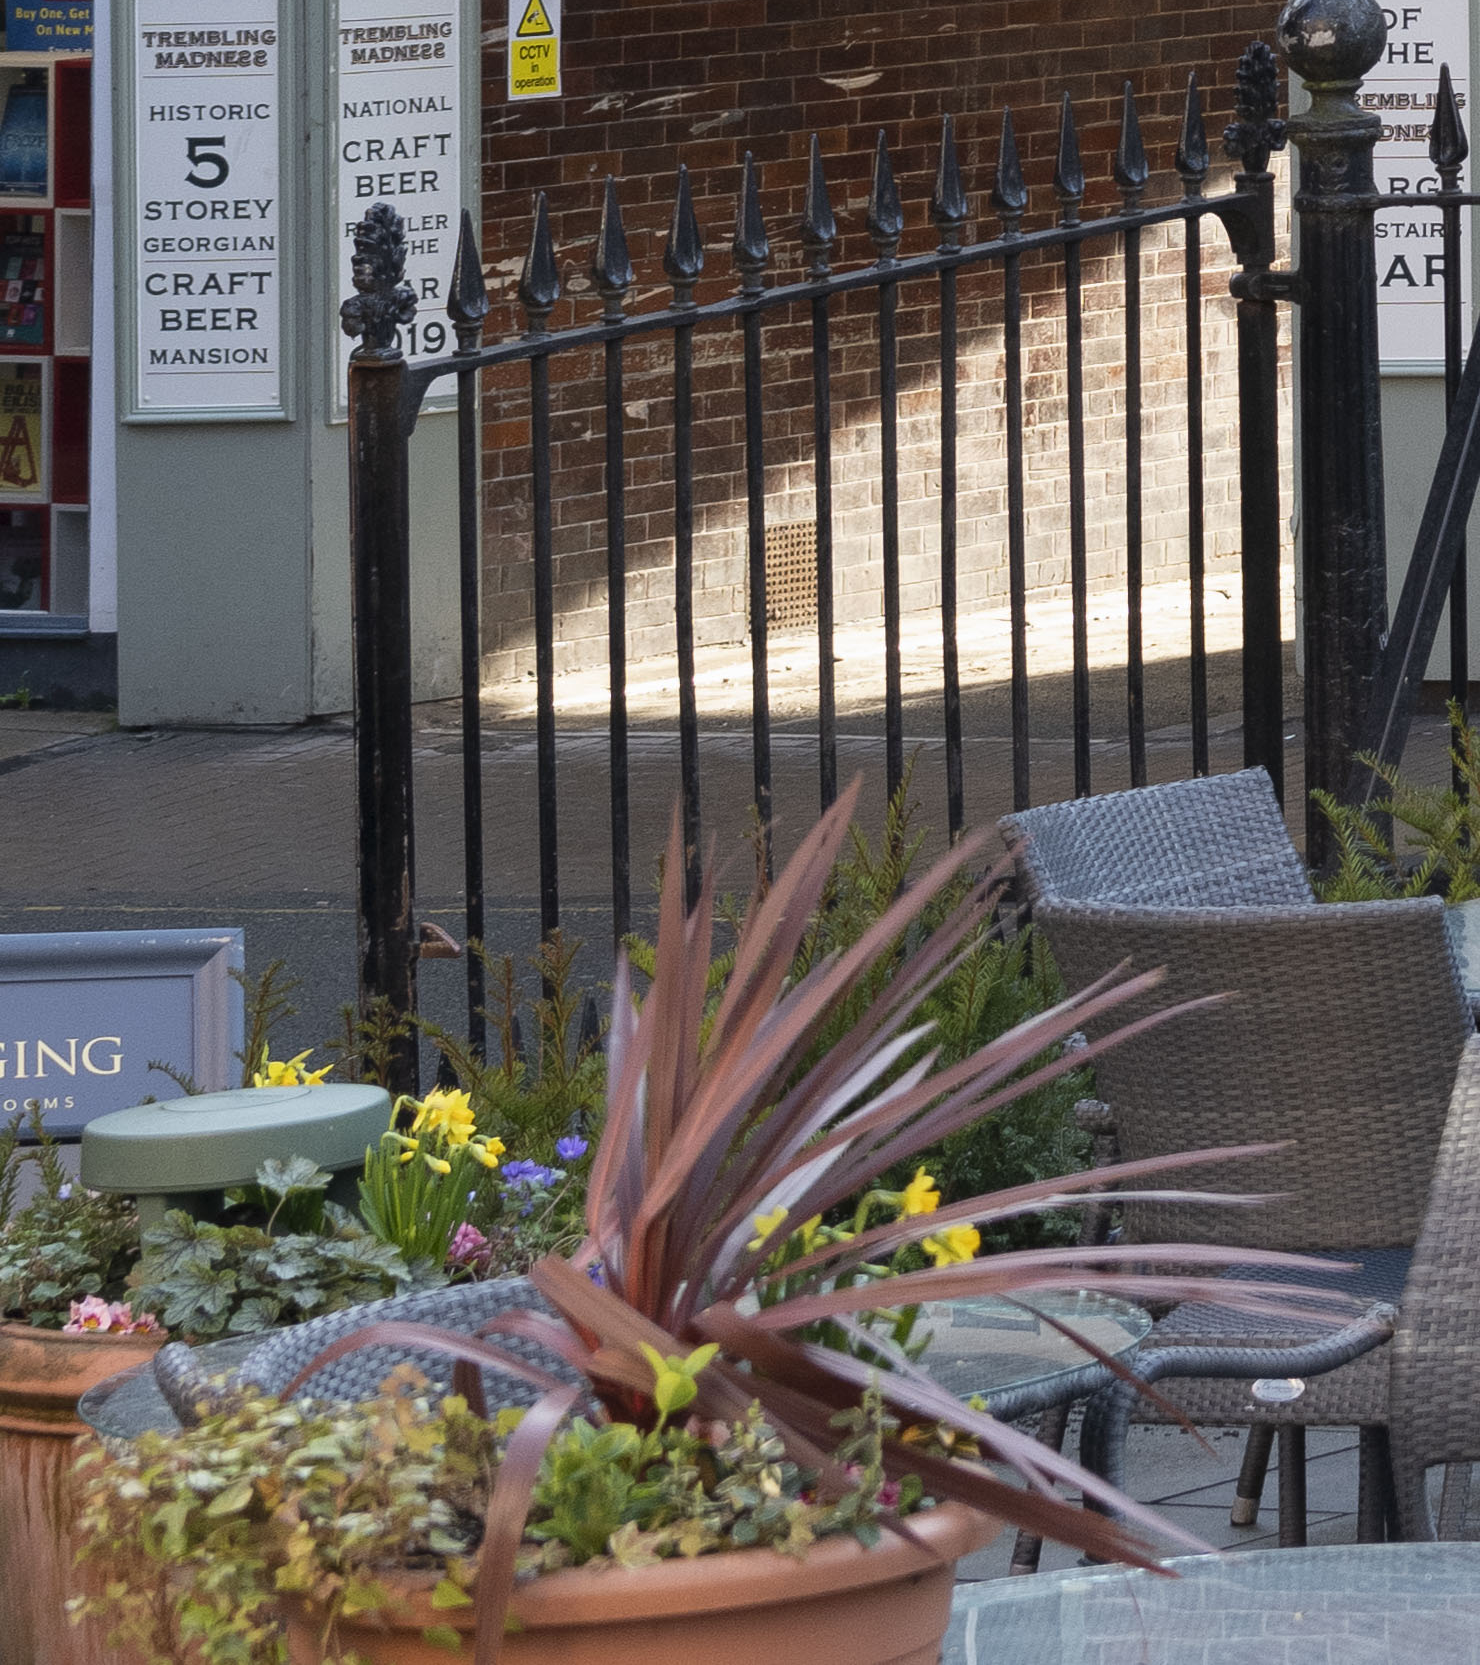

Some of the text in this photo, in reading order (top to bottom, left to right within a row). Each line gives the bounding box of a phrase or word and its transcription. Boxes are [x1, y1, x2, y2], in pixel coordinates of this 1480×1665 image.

[16, 7, 37, 22] Buy
[69, 7, 90, 20] Get
[36, 25, 52, 36] On
[56, 25, 81, 36] New
[142, 30, 276, 47] TREMBLING
[340, 22, 452, 44] TREMBLING
[155, 50, 268, 69] MADNESS
[351, 42, 445, 64] MADNESS
[520, 44, 550, 60] CCTV
[1381, 41, 1434, 64] HE
[531, 62, 539, 73] in
[515, 76, 555, 90] operation
[150, 104, 270, 121] HISTORIC
[343, 96, 452, 118] NATIONAL
[343, 133, 451, 163] CRAFT
[184, 135, 229, 188] 5
[355, 170, 440, 197] BEER
[144, 199, 273, 220] STOREY
[144, 236, 275, 252] GEORGIAN
[145, 271, 272, 295] CRAFT
[160, 308, 258, 331] BEER
[150, 348, 268, 365] MANSION
[0, 1036, 124, 1079] ING
